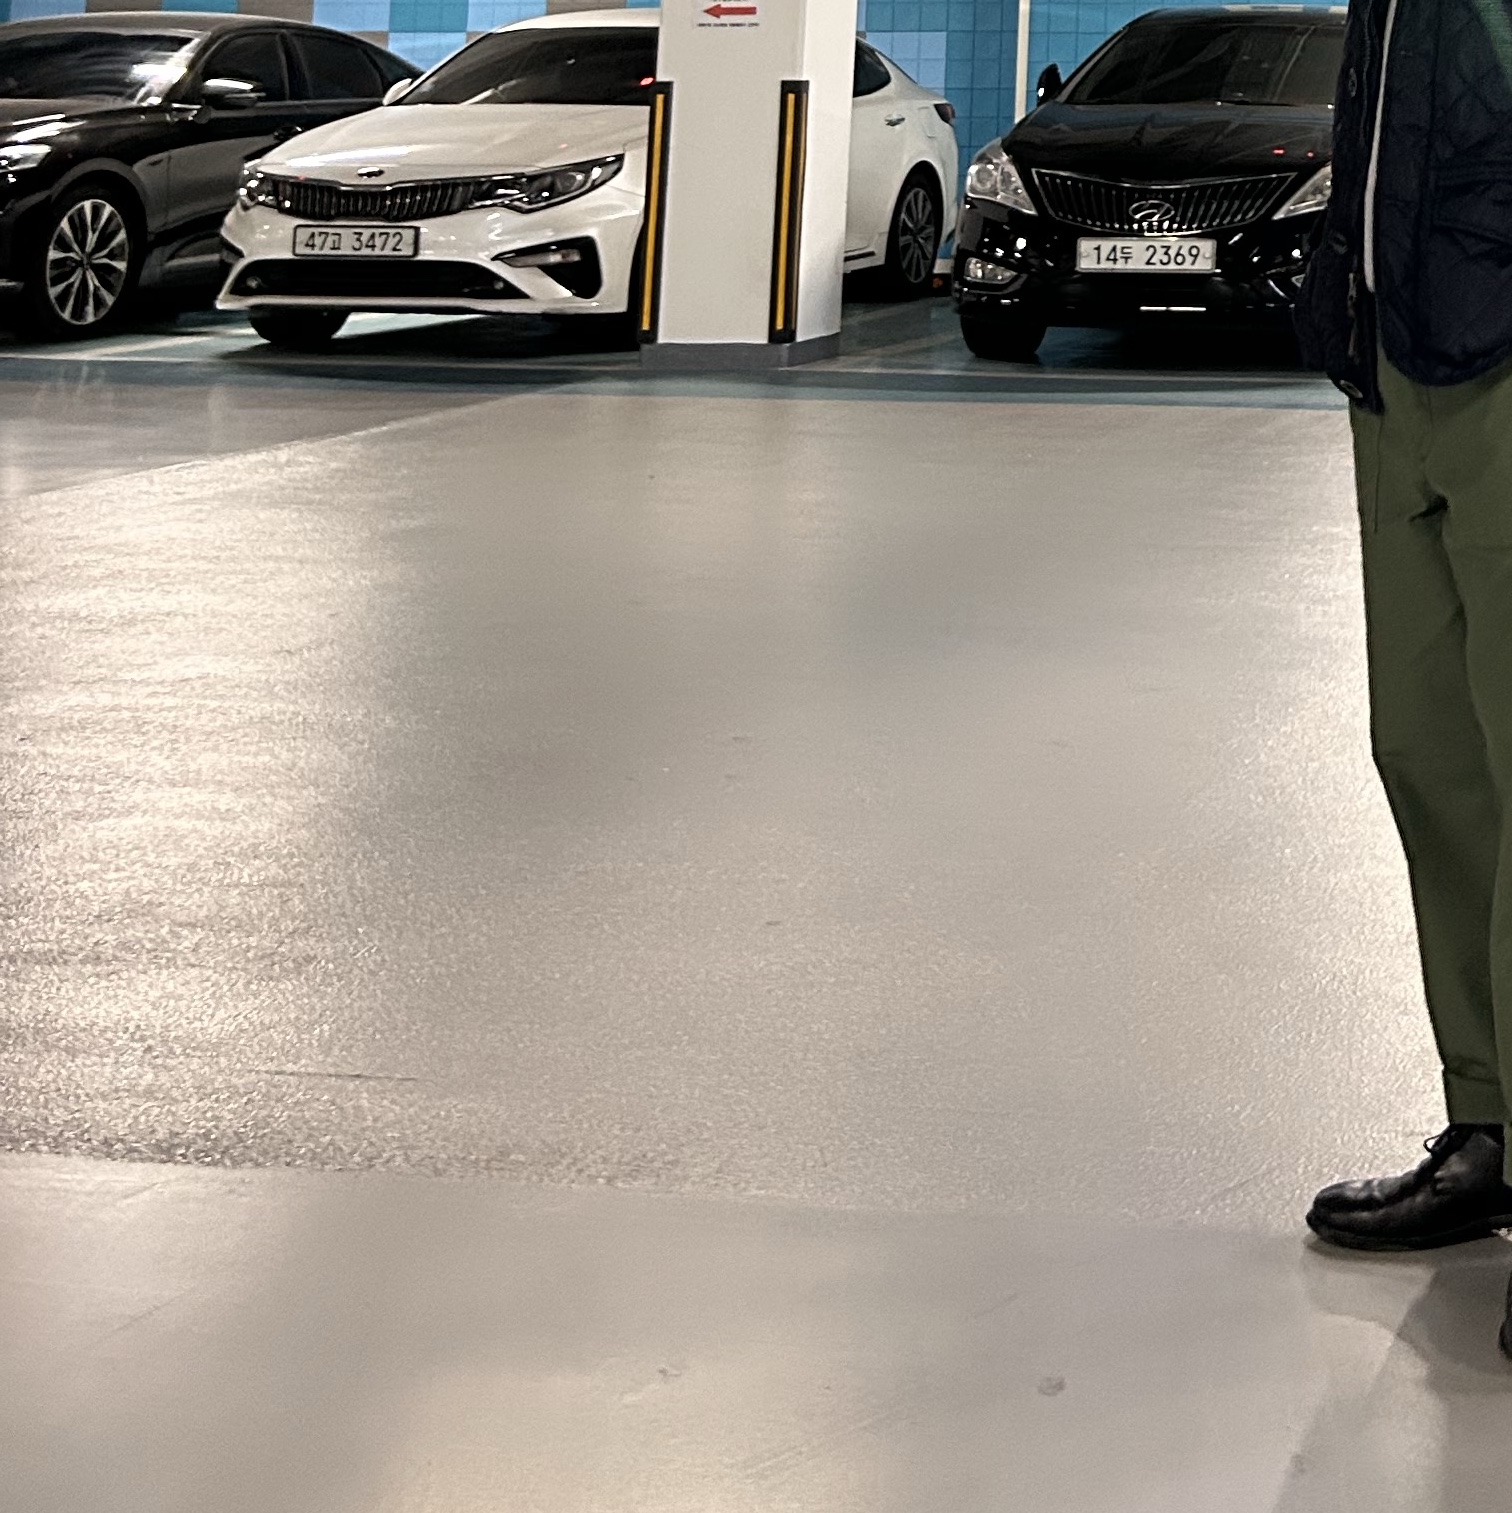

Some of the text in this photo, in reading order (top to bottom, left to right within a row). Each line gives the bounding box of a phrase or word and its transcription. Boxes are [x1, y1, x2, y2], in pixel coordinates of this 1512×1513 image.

[304, 231, 403, 252] 47고 3472
[1093, 244, 1200, 266] 14두 2369
